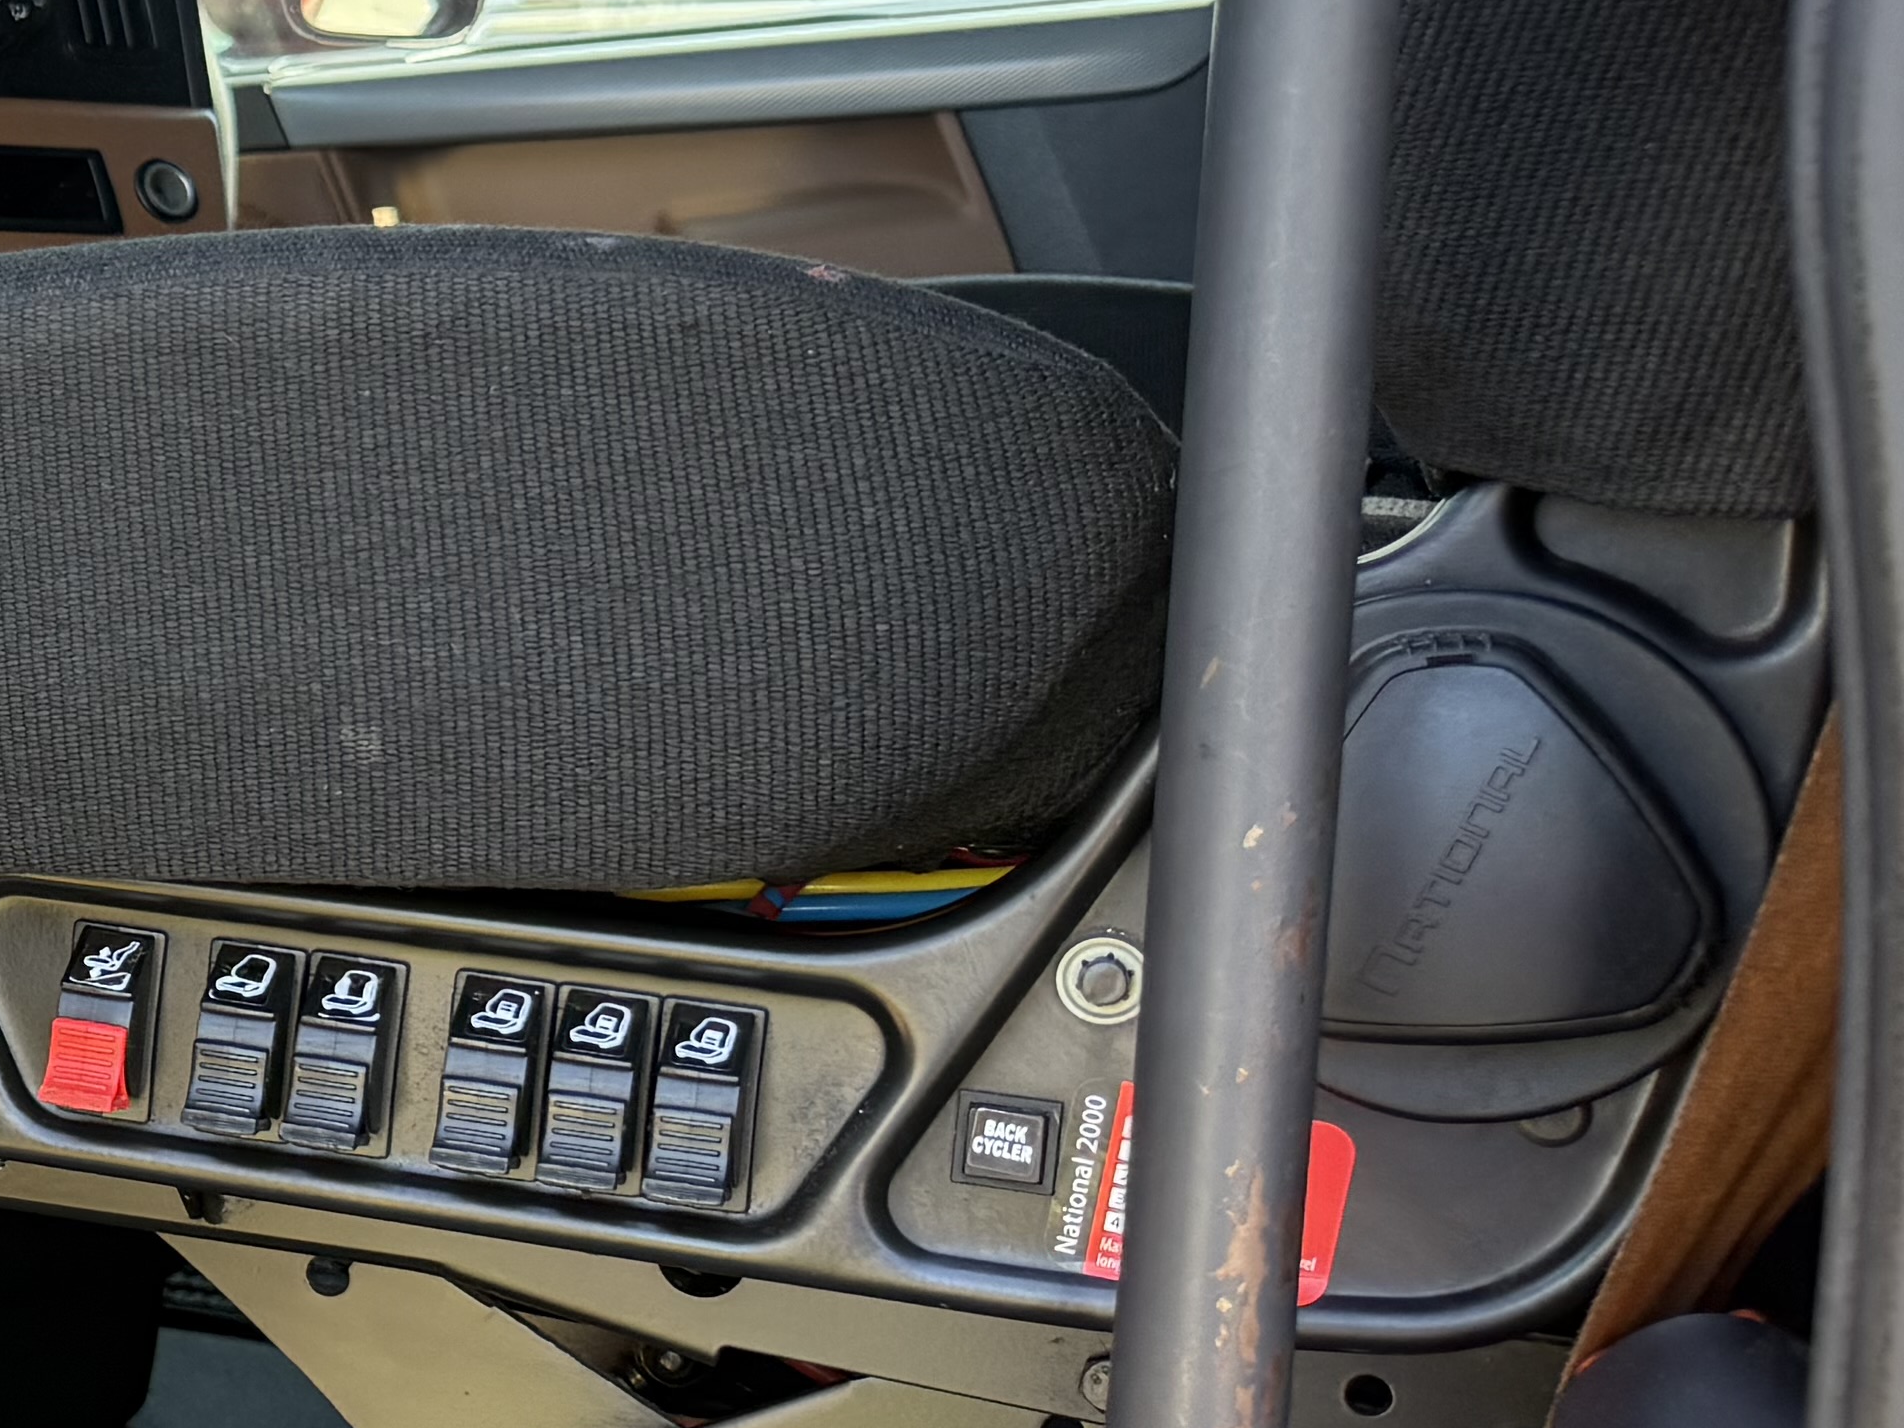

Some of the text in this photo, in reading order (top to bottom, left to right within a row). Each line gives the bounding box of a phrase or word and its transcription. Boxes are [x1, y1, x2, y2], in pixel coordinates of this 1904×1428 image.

[983, 1118, 1028, 1144] BACK
[970, 1135, 1033, 1165] CYCLER
[1054, 1094, 1107, 1255] National 2000
